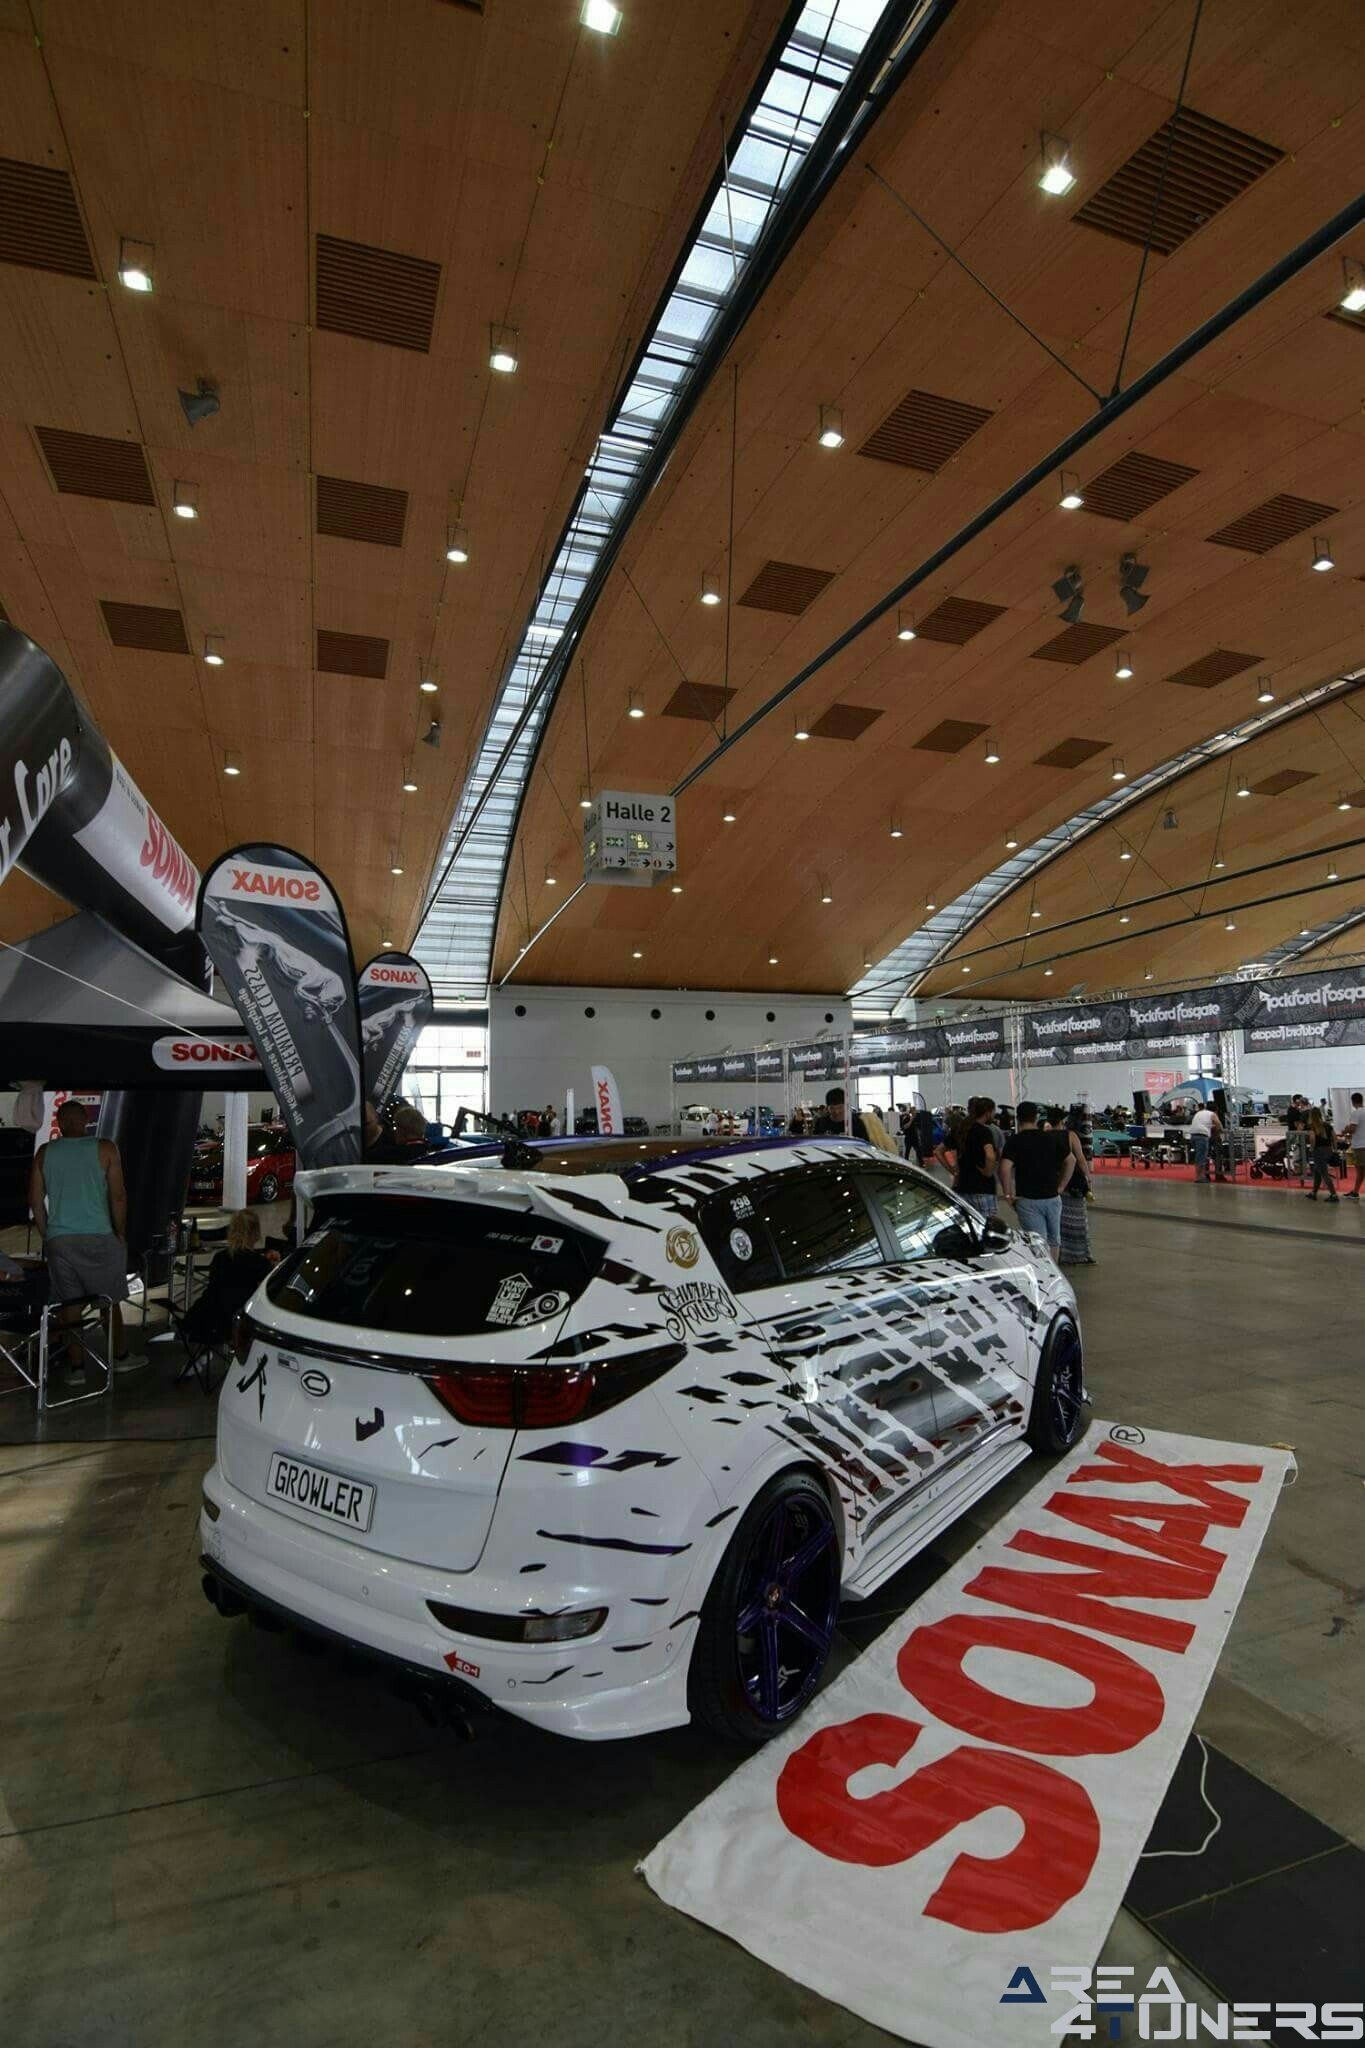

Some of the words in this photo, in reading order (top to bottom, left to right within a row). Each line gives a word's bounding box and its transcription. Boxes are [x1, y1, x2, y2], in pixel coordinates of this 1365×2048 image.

[606, 801, 654, 821] Halle
[660, 806, 671, 823] 2
[370, 968, 418, 984] SONAX
[730, 1194, 751, 1211] 298
[275, 1461, 363, 1522] GROWLER
